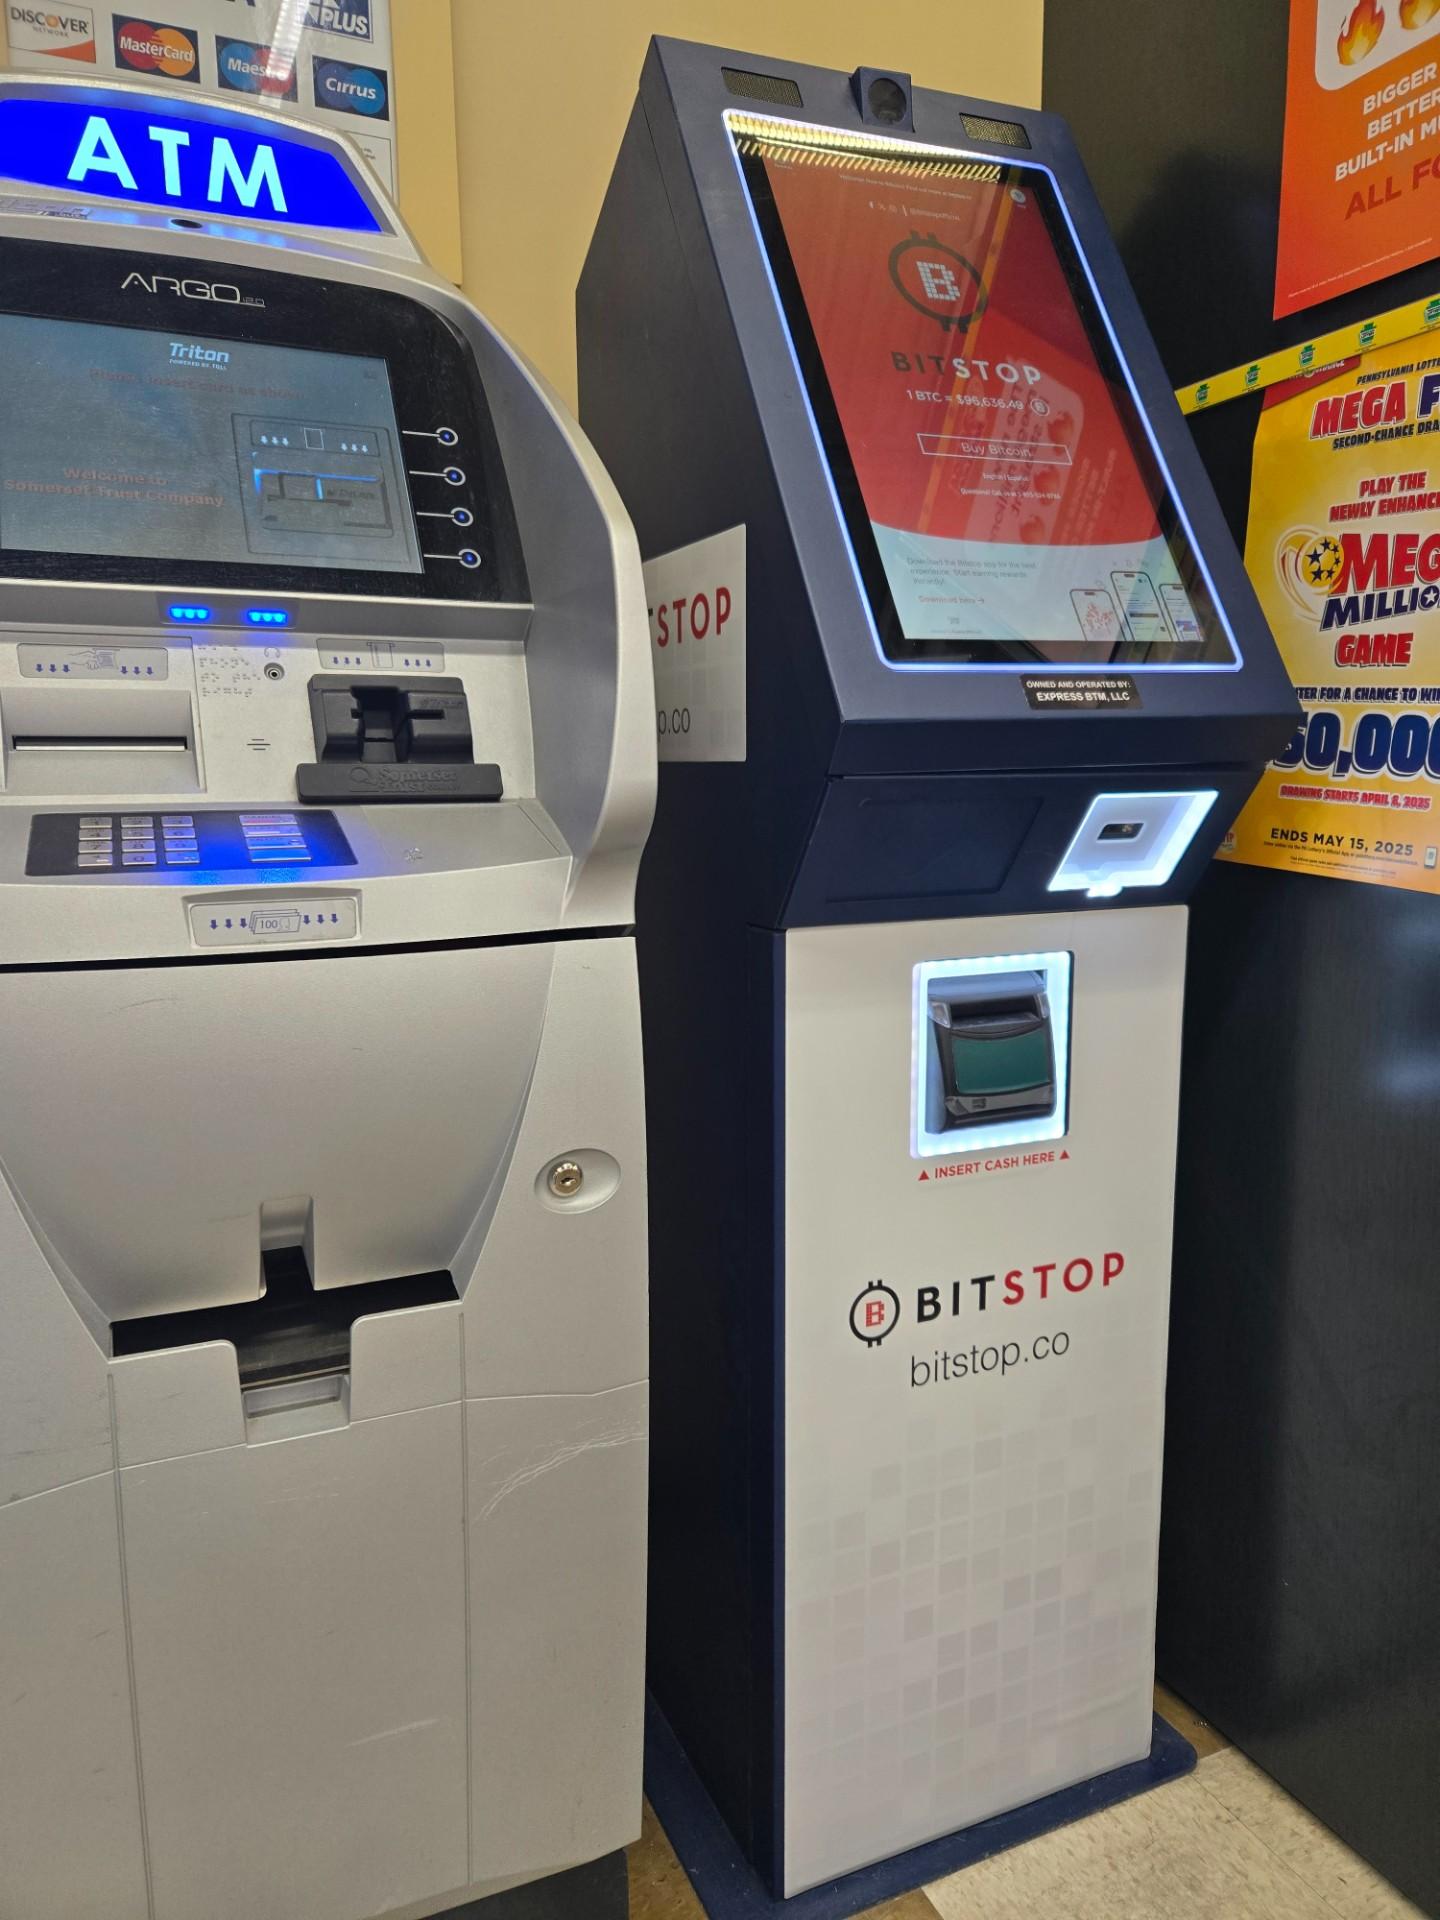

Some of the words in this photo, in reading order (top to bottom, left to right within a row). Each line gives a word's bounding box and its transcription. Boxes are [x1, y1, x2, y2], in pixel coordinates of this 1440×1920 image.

[10, 7, 89, 34] DISCOVER
[319, 8, 369, 35] PLUS
[119, 36, 193, 62] MasterCard
[325, 78, 377, 99] Cirrus
[1363, 62, 1437, 115] BIGGER
[1335, 129, 1414, 182] BUILT-IN
[1420, 115, 1440, 140] M
[67, 115, 288, 212] ATM
[1345, 176, 1402, 221] ALL
[121, 272, 241, 304] ARGO
[169, 342, 229, 363] Triton
[892, 351, 1040, 384] BITSTOP
[1357, 364, 1413, 384] PENNSYLVANIA
[907, 390, 913, 399] 1
[915, 391, 942, 402] BTC
[1310, 382, 1406, 439] MEGA
[961, 442, 984, 455] Buy
[988, 444, 1032, 457] Bitcoin
[1333, 424, 1414, 450] SECOND-CHANCE
[64, 467, 145, 485] Welcome
[1359, 476, 1395, 498] PLAY
[1398, 471, 1427, 491] THE
[4, 479, 88, 497] Somerset
[99, 486, 140, 499] Trust
[146, 491, 224, 508] Company
[1330, 500, 1376, 522] NEWLY
[648, 587, 731, 648] STOP
[1321, 585, 1440, 631] MILLIO
[1336, 632, 1414, 667] GAME
[1026, 680, 1056, 688] OWNED
[1036, 692, 1083, 701] EXPRESS
[1084, 692, 1110, 703] BTM,
[1110, 692, 1130, 701] LLC
[1296, 687, 1318, 702] TER
[1320, 687, 1343, 702] FOR
[1344, 687, 1351, 702] A
[1354, 687, 1399, 703] CHANCE
[1400, 688, 1418, 703] TO
[1280, 785, 1322, 799] DRAWING
[1324, 789, 1359, 803] STARTS
[1360, 791, 1389, 805] APRIL
[1403, 796, 1431, 810] 2025
[1271, 828, 1308, 842] ENDS
[1314, 834, 1344, 847] MAY
[1350, 837, 1369, 853] 15,
[1375, 841, 1413, 856] 2025
[260, 919, 278, 929] 100
[935, 1162, 980, 1179] INSERT
[985, 1157, 1019, 1171] CASH
[1023, 1152, 1055, 1166] HERE
[917, 1252, 1125, 1323] BITSTOP
[911, 1332, 1070, 1387] bitstop.co
